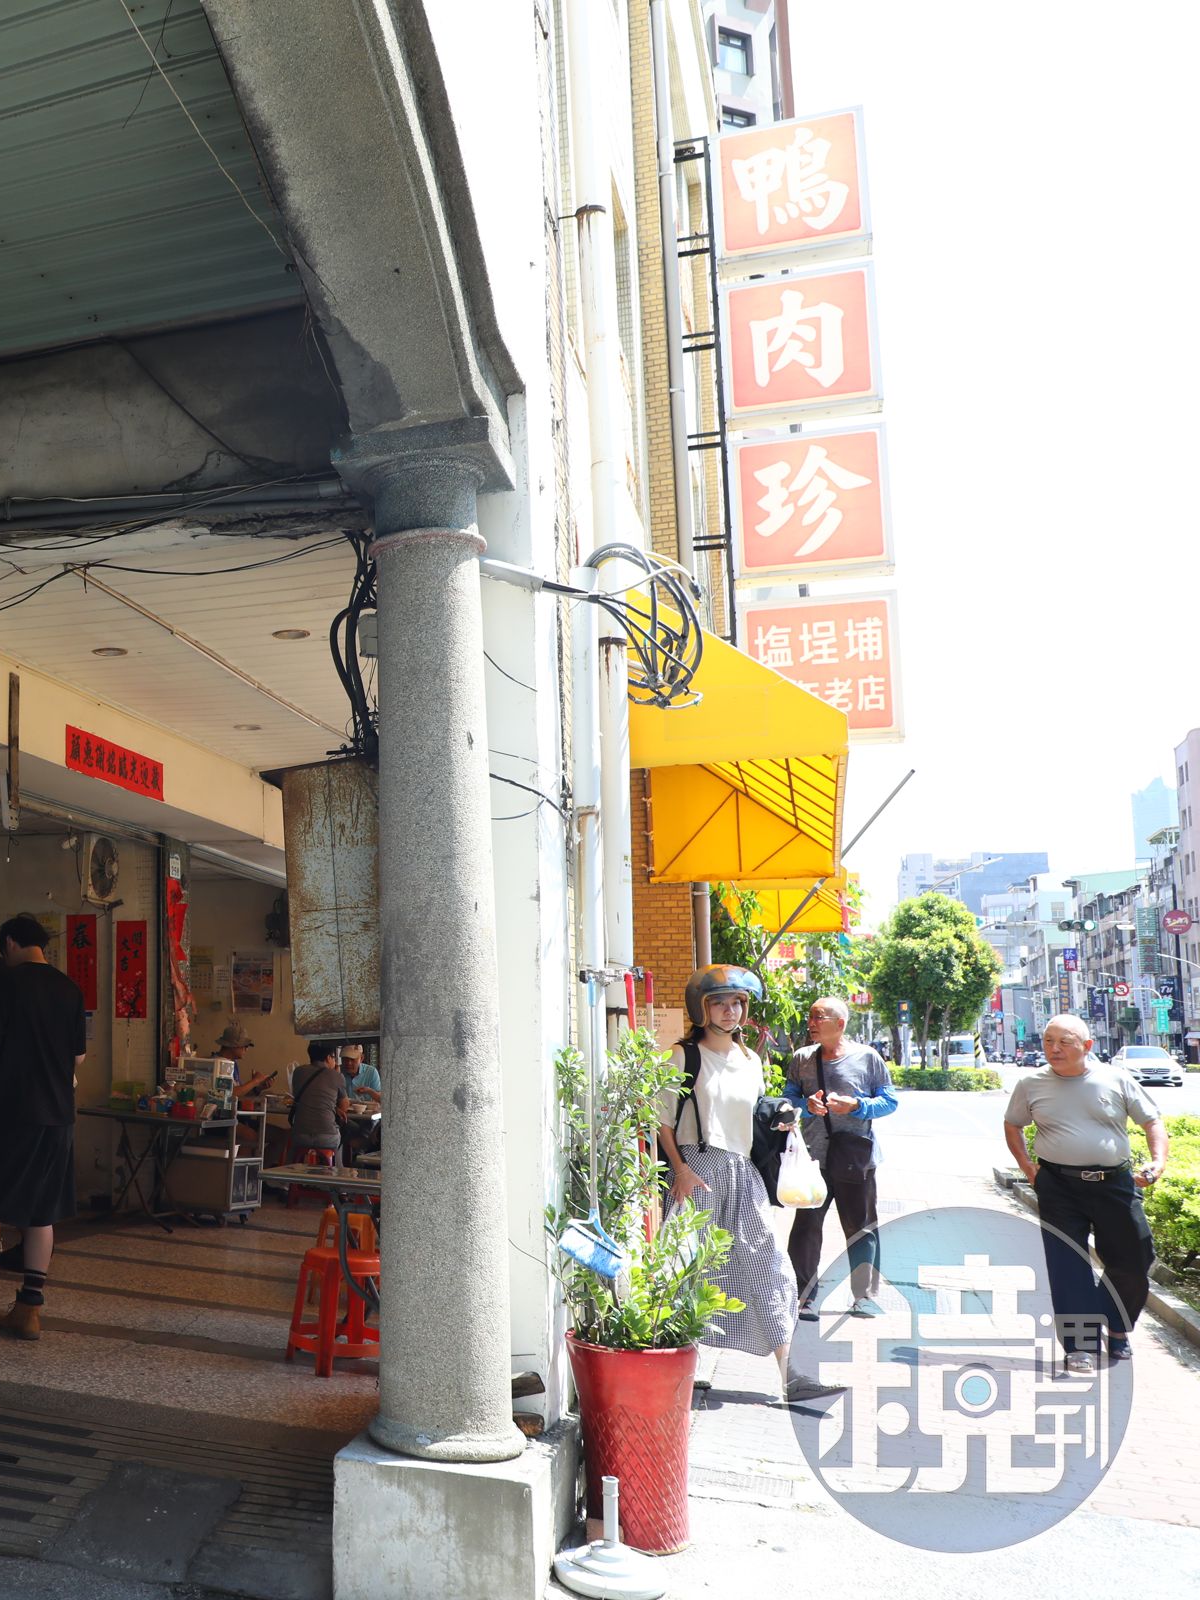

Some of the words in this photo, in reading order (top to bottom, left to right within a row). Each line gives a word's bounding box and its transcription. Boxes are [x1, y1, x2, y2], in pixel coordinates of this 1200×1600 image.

[732, 127, 872, 557] 鴨肉珍
[754, 616, 884, 669] 塩埕埔
